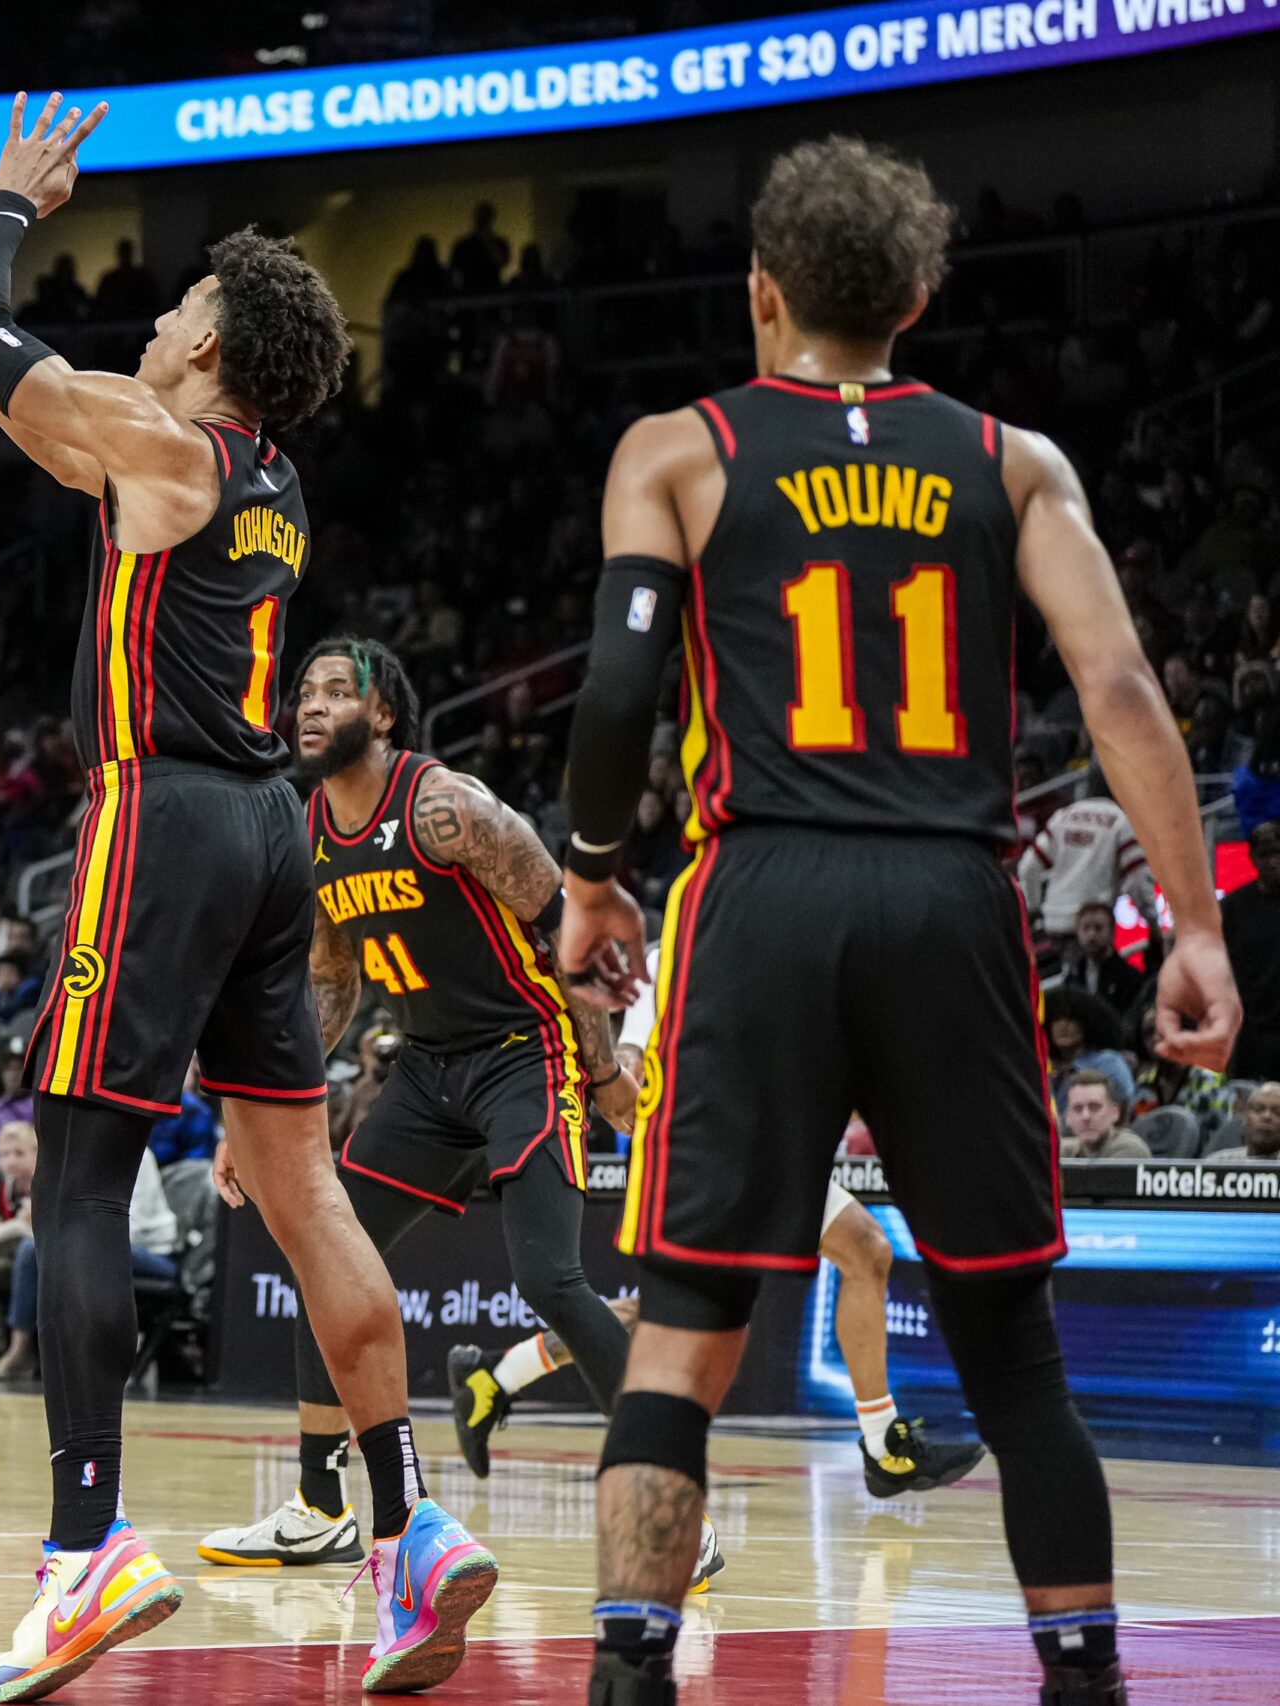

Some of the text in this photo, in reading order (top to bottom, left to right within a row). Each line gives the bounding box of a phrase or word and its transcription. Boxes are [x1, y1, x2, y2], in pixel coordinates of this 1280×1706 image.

[176, 90, 314, 142] CHASE
[323, 56, 658, 129] CARDHOLDERS:
[671, 41, 751, 94] GET
[758, 30, 836, 86] $20
[844, 16, 927, 71] OFF
[936, 0, 1097, 60] MERCH
[776, 463, 953, 537] YOUNG
[228, 505, 306, 579] JOHNSON
[241, 593, 279, 734] 1
[780, 559, 969, 758] 11
[316, 868, 425, 926] HAWKS
[362, 932, 430, 995] 41
